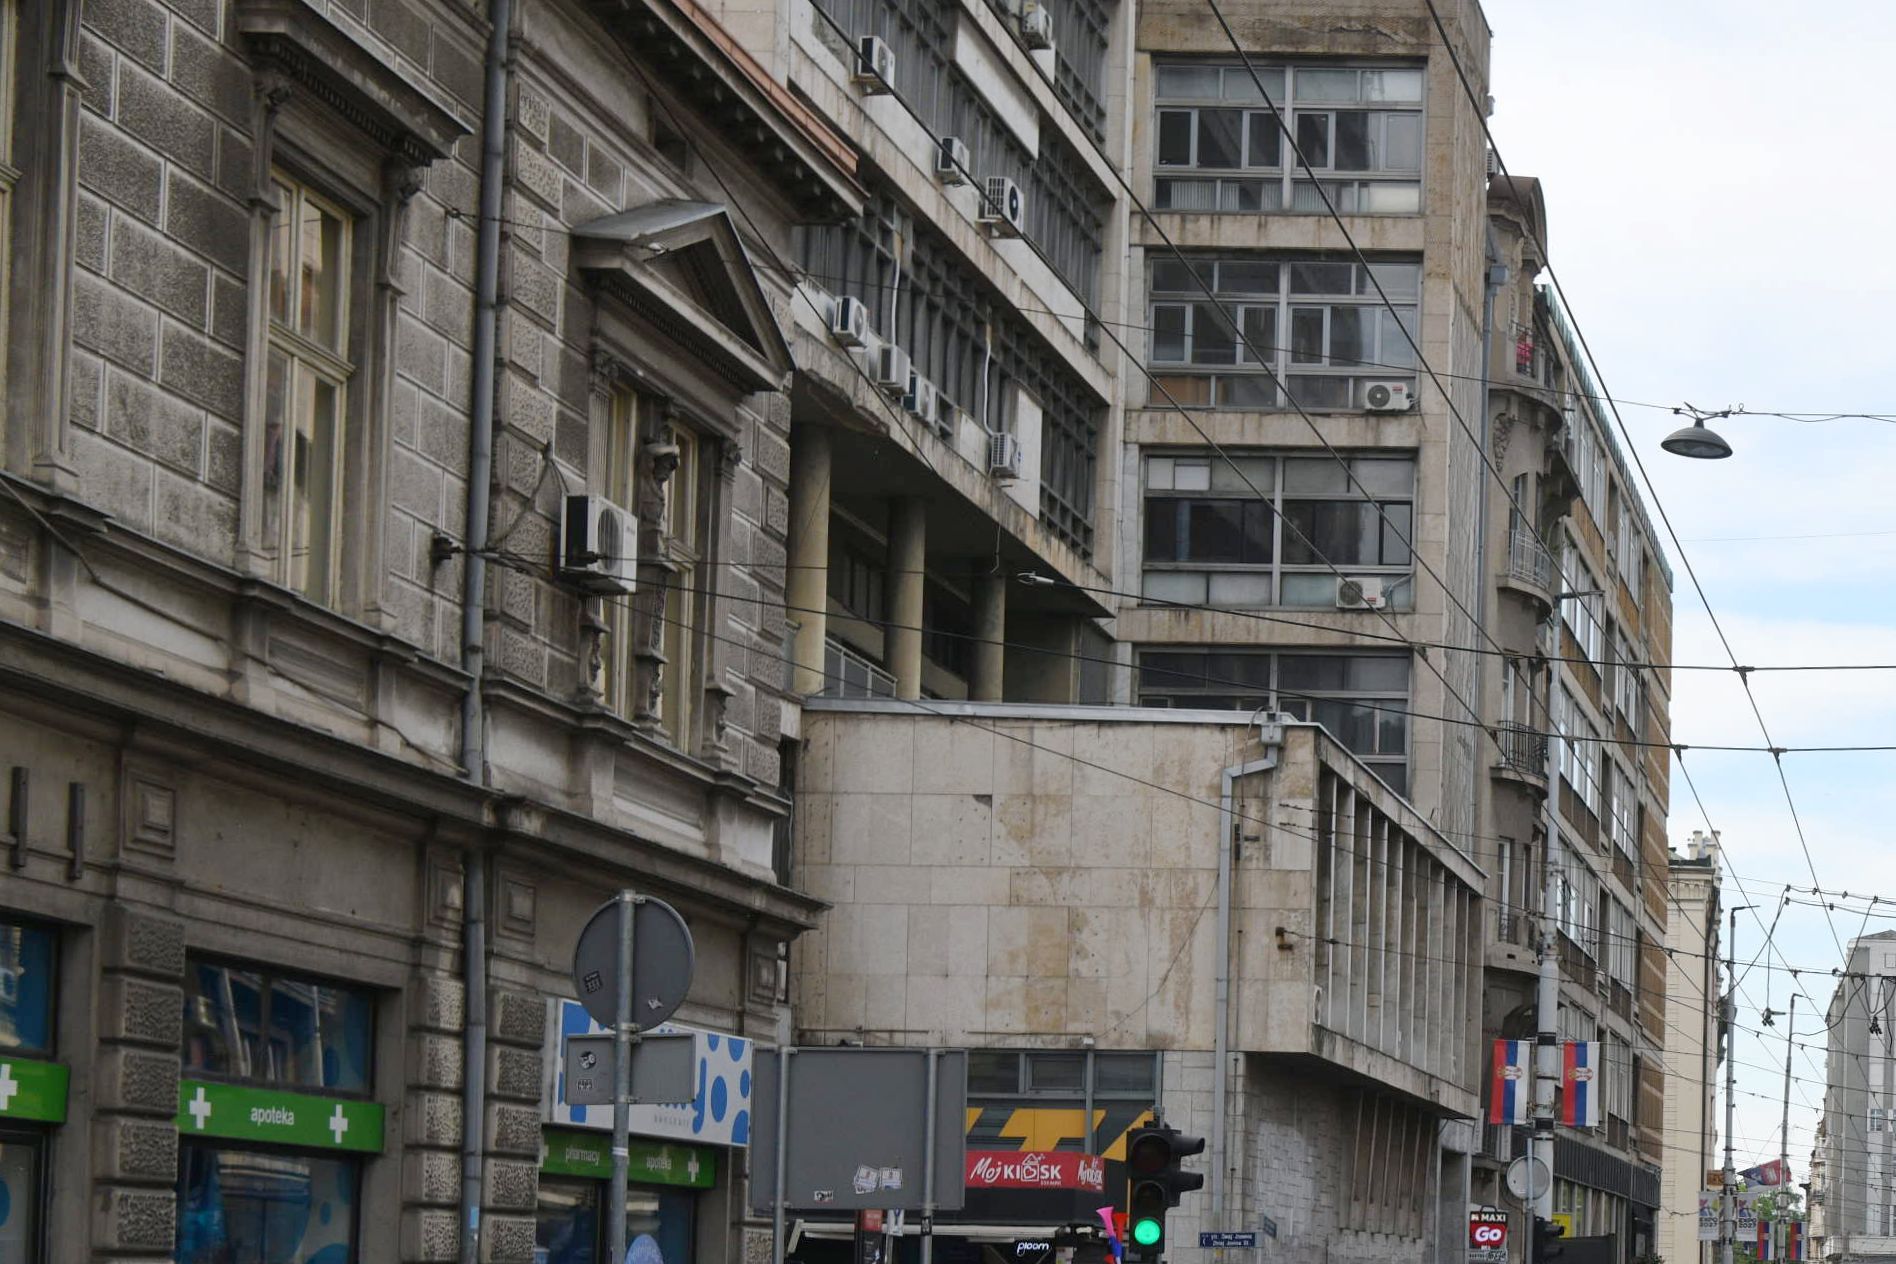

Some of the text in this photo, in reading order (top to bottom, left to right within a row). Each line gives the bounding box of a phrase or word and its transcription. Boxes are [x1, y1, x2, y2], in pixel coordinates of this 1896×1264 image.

[250, 1107, 295, 1126] apoteka
[565, 1147, 600, 1166] pharmacy
[970, 1157, 1002, 1183] Moj
[1481, 1213, 1506, 1221] MAXI
[1017, 1241, 1050, 1257] ploom
